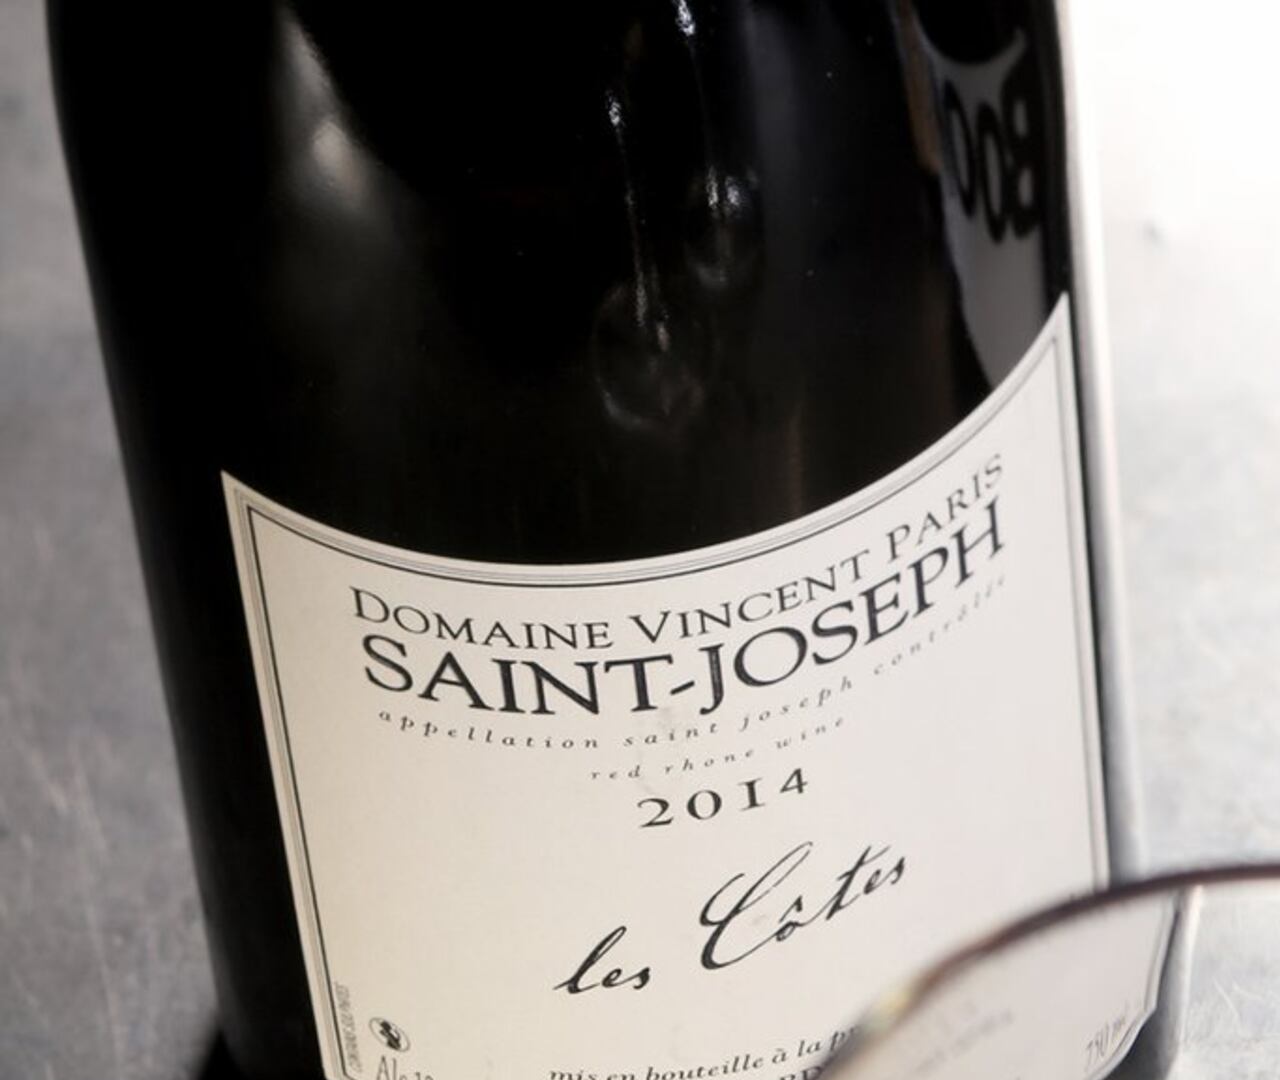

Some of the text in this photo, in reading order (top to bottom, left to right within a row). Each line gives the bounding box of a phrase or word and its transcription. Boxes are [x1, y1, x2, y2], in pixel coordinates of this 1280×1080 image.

[349, 453, 1002, 651] DOMAINE VINCENT PARIS
[362, 495, 1005, 717] SAINT-JOSEPH
[379, 708, 599, 749] appellation
[623, 722, 719, 748] saint
[736, 675, 854, 732] joseph
[591, 716, 845, 781] red rhone wine
[636, 767, 809, 829] 2014
[553, 925, 651, 994] les
[796, 1038, 821, 1058] la
